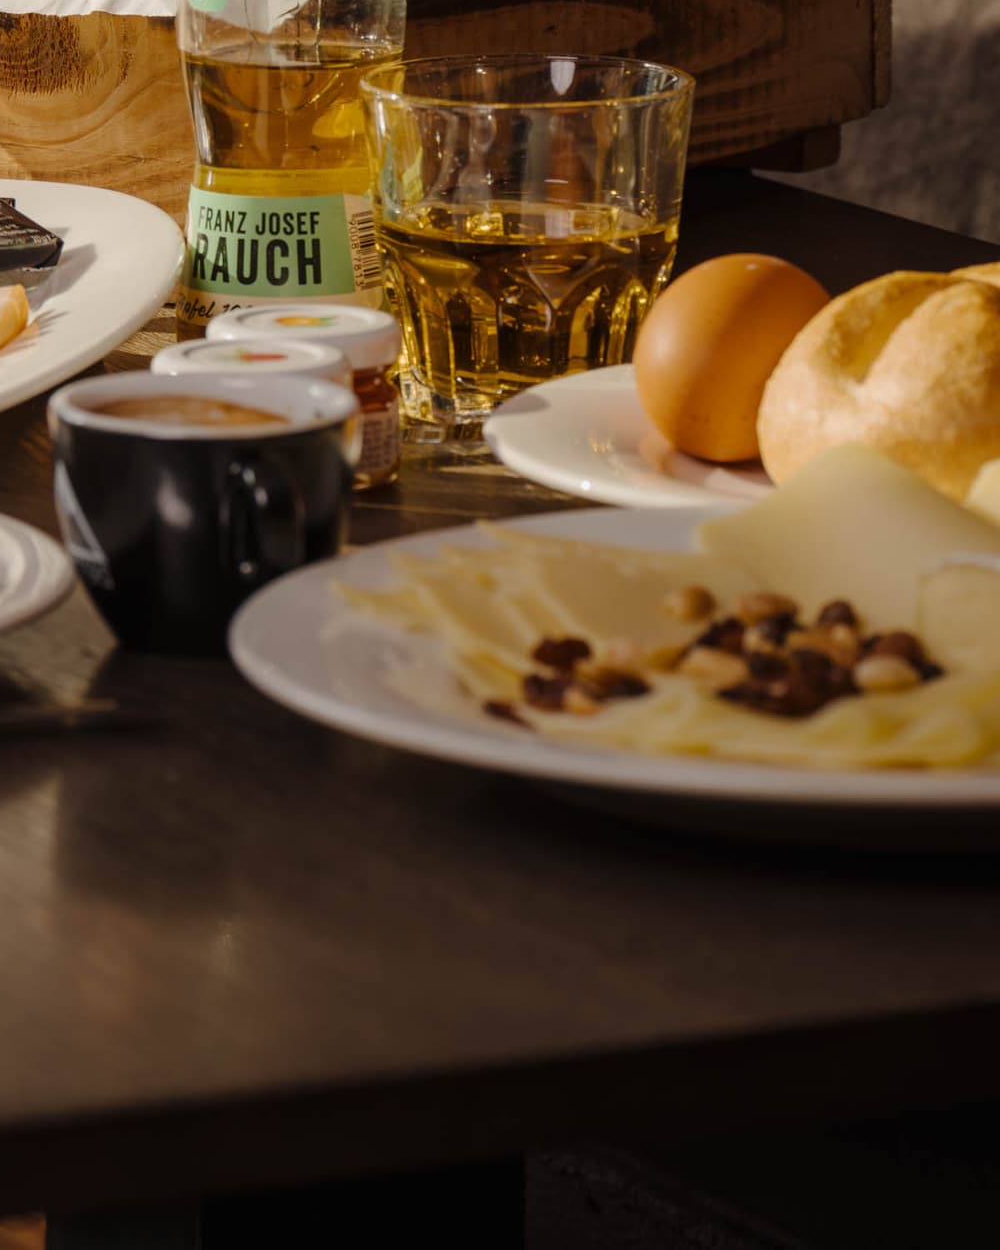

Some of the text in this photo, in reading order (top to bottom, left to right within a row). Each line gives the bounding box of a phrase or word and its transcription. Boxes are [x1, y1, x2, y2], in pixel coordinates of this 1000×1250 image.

[199, 206, 321, 236] FRANZ JOSEF
[192, 232, 323, 287] RAUCH
